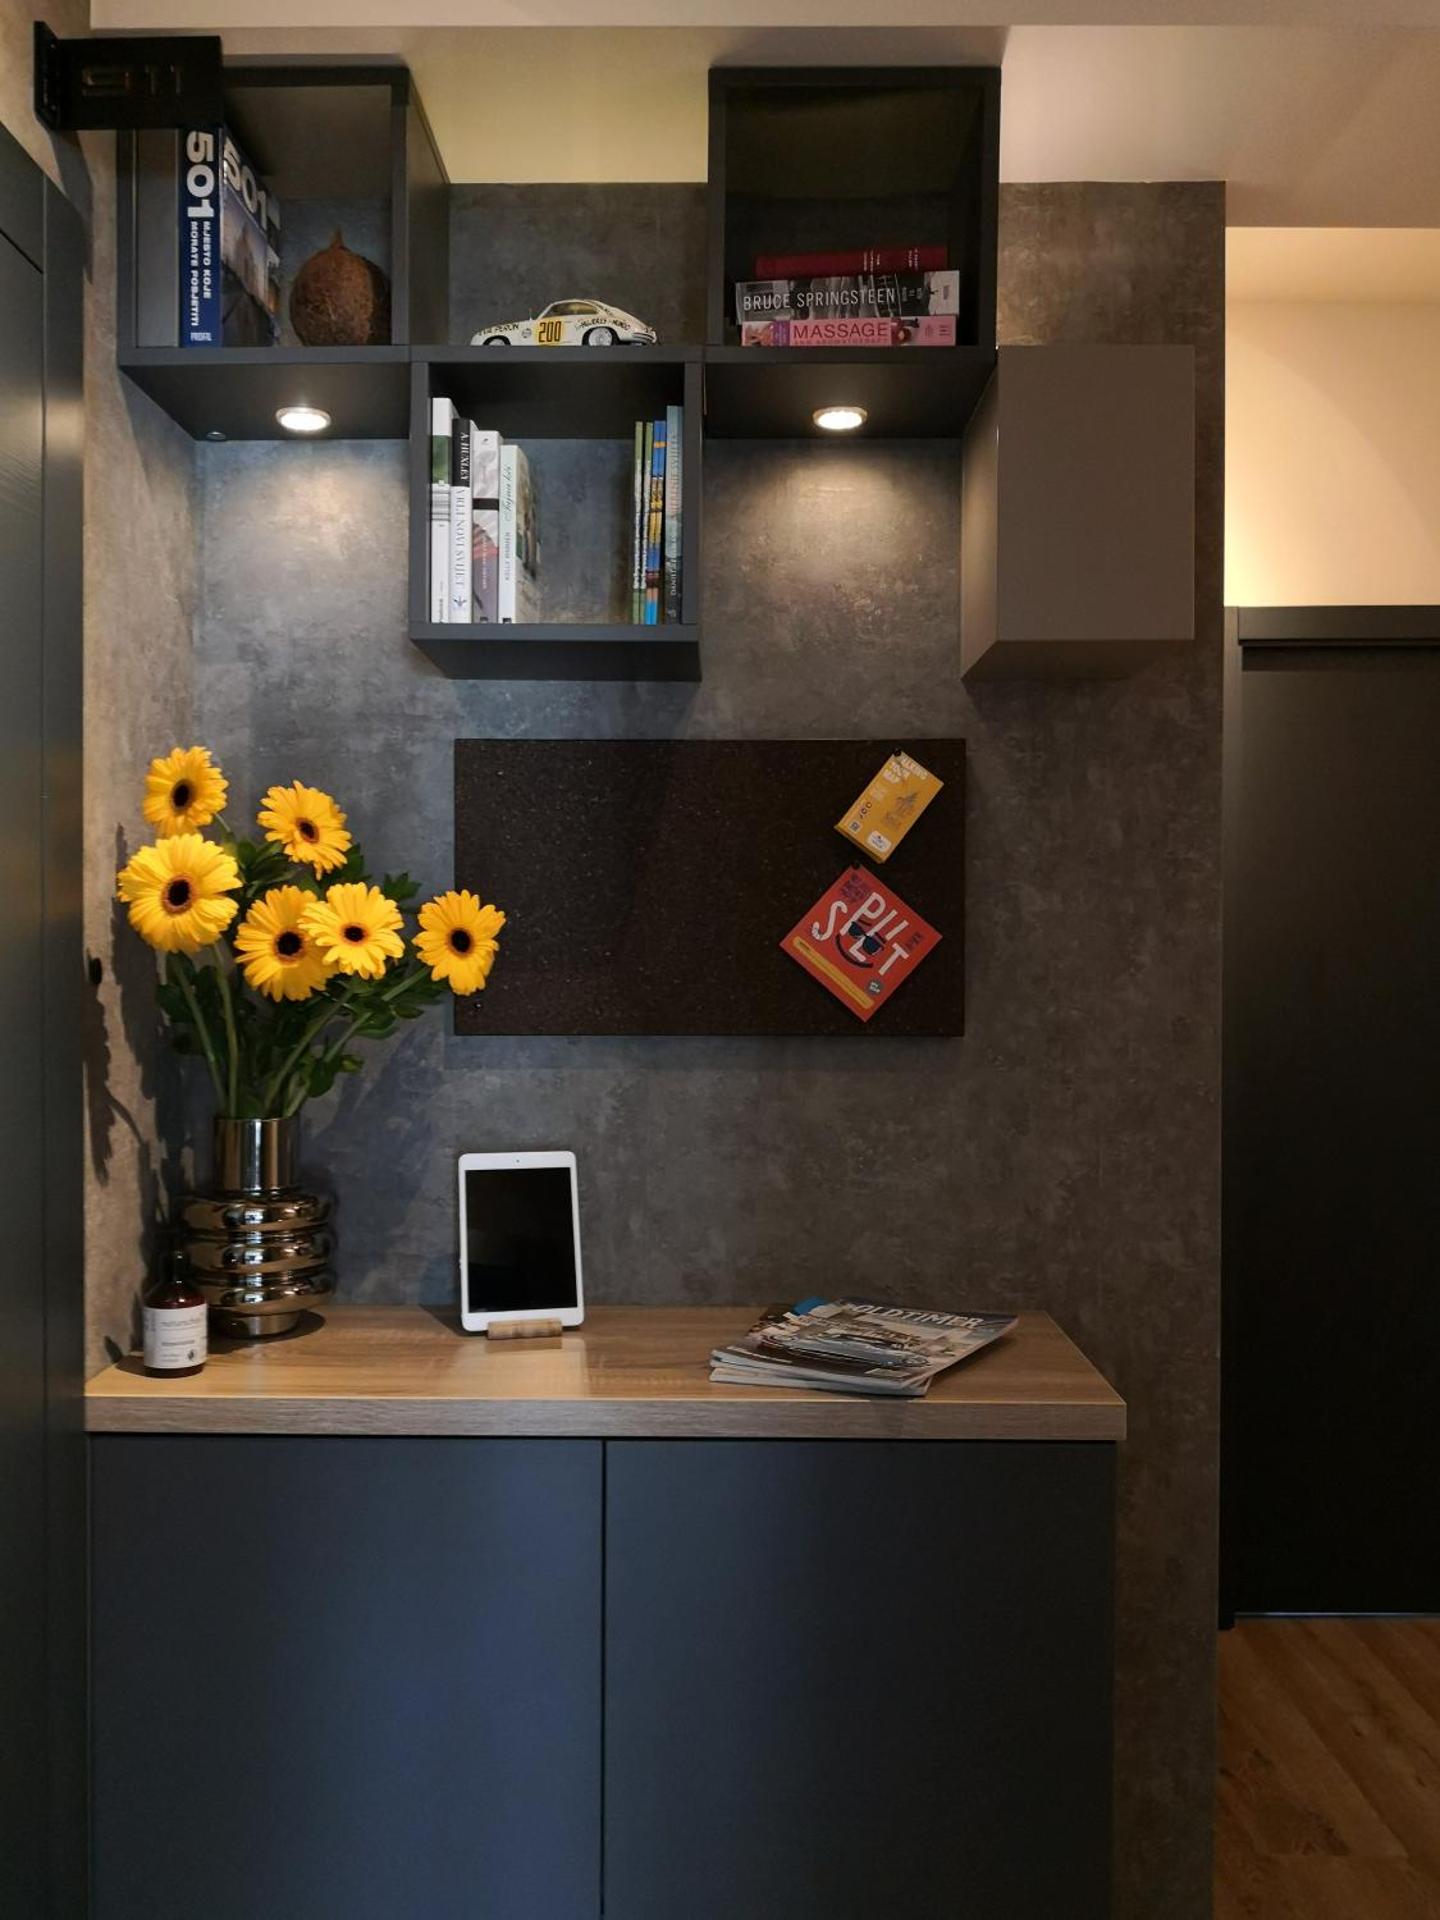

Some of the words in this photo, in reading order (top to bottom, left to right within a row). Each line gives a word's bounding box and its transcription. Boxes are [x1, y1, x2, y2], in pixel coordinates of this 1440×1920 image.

[186, 130, 215, 218] 501
[190, 221, 200, 266] MORATE
[202, 269, 212, 299] KOJE
[743, 293, 791, 312] BRUCE
[796, 287, 895, 309] SPRINGSTEEN
[538, 321, 562, 343] 200
[793, 322, 888, 339] MASSAGE
[460, 442, 470, 481] HUXLEY
[455, 521, 465, 547] NOVI
[455, 550, 465, 586] SVIJET
[811, 891, 910, 976] SPLIT
[851, 1304, 985, 1329] OLDTIMER
